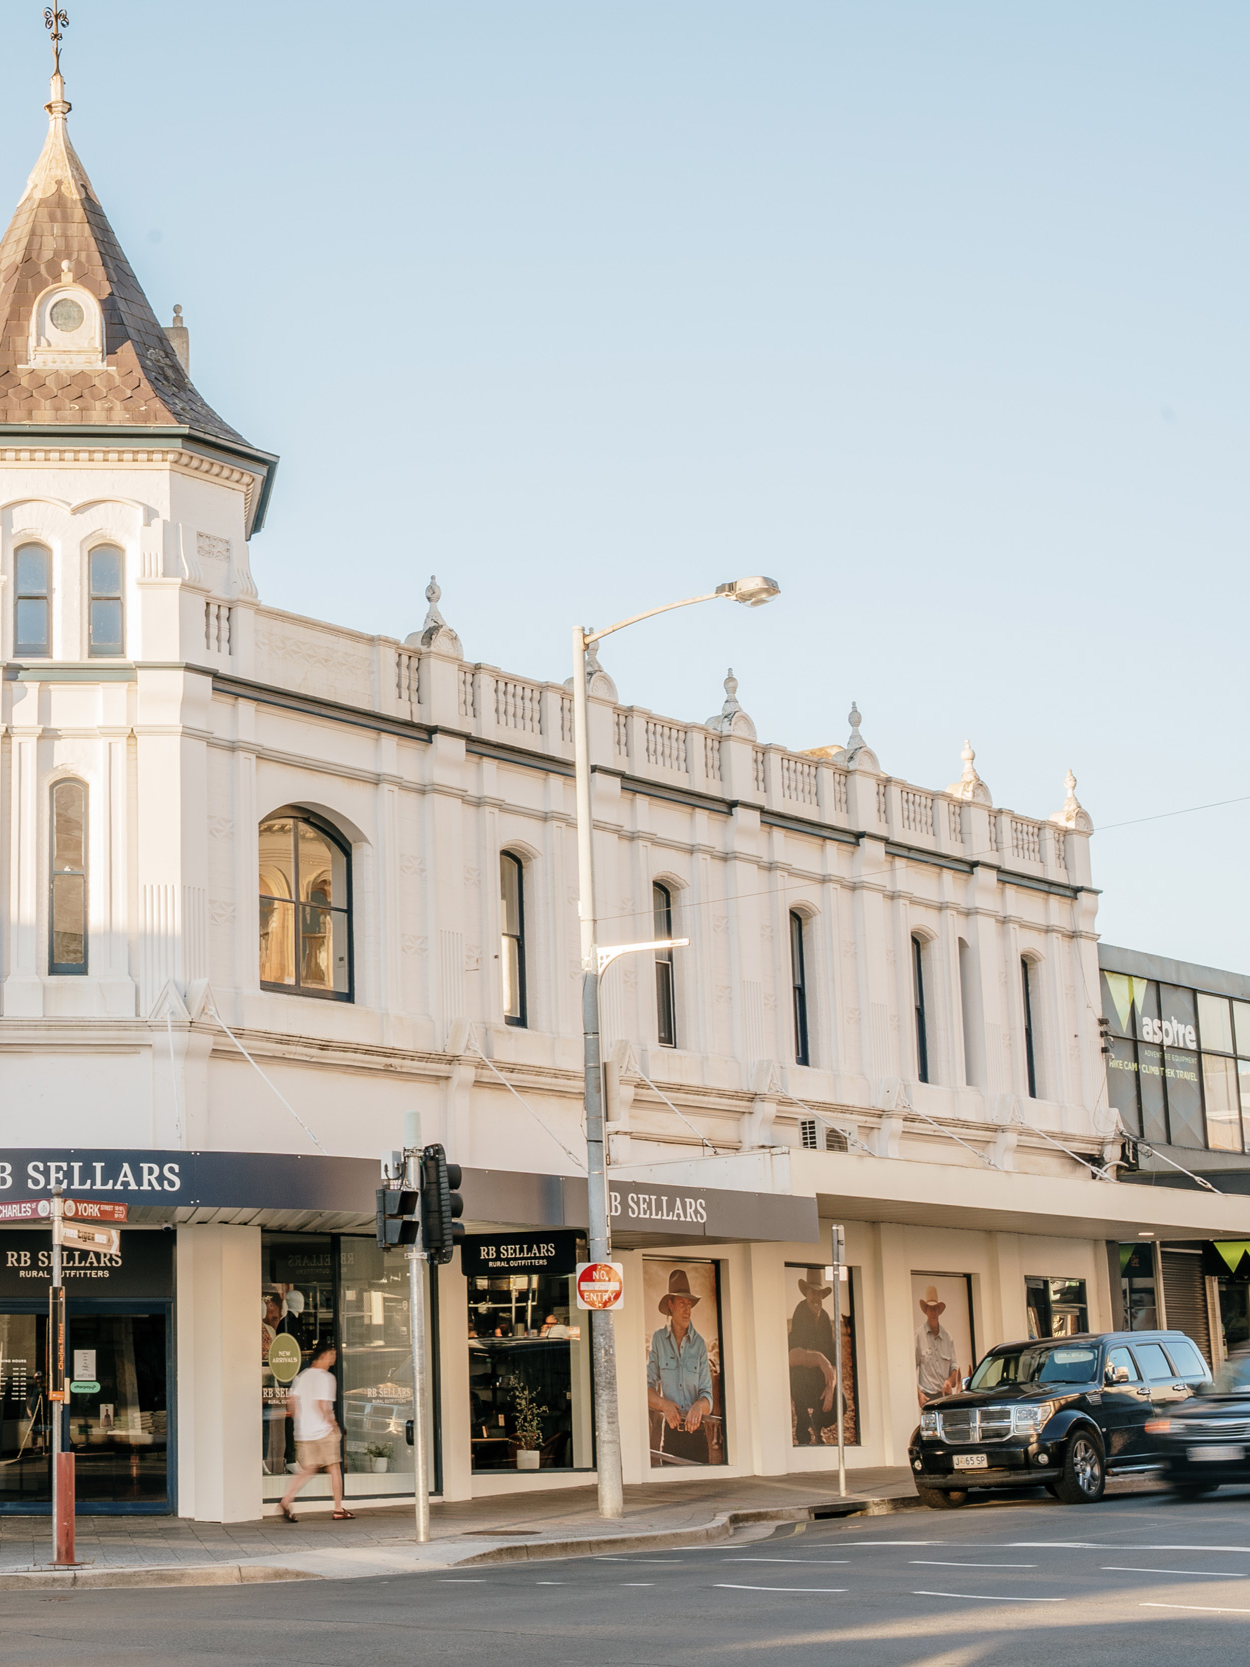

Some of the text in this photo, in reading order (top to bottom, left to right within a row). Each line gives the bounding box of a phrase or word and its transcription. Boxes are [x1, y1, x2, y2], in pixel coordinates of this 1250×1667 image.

[1142, 1016, 1197, 1050] aspire
[1145, 1050, 1197, 1064] ADVENTRE EQUIPMENT
[1124, 1061, 1141, 1072] CAM
[1142, 1064, 1160, 1075] CLIMB
[1176, 1069, 1197, 1082] TRAVEL
[27, 1161, 181, 1191] SELLARS
[77, 1202, 100, 1217] YORK
[627, 1193, 707, 1223] SELLARS
[480, 1243, 556, 1259] RB SELLARS
[6, 1251, 31, 1267] RB
[510, 1259, 548, 1267] OUTFITTERS
[52, 1270, 110, 1278] UTFITTERS
[592, 1270, 607, 1280] NO
[584, 1292, 616, 1302] ENTRY
[272, 1356, 298, 1364] ARRIVALS
[263, 1388, 273, 1398] RB
[367, 1387, 411, 1398] RB SELLARS
